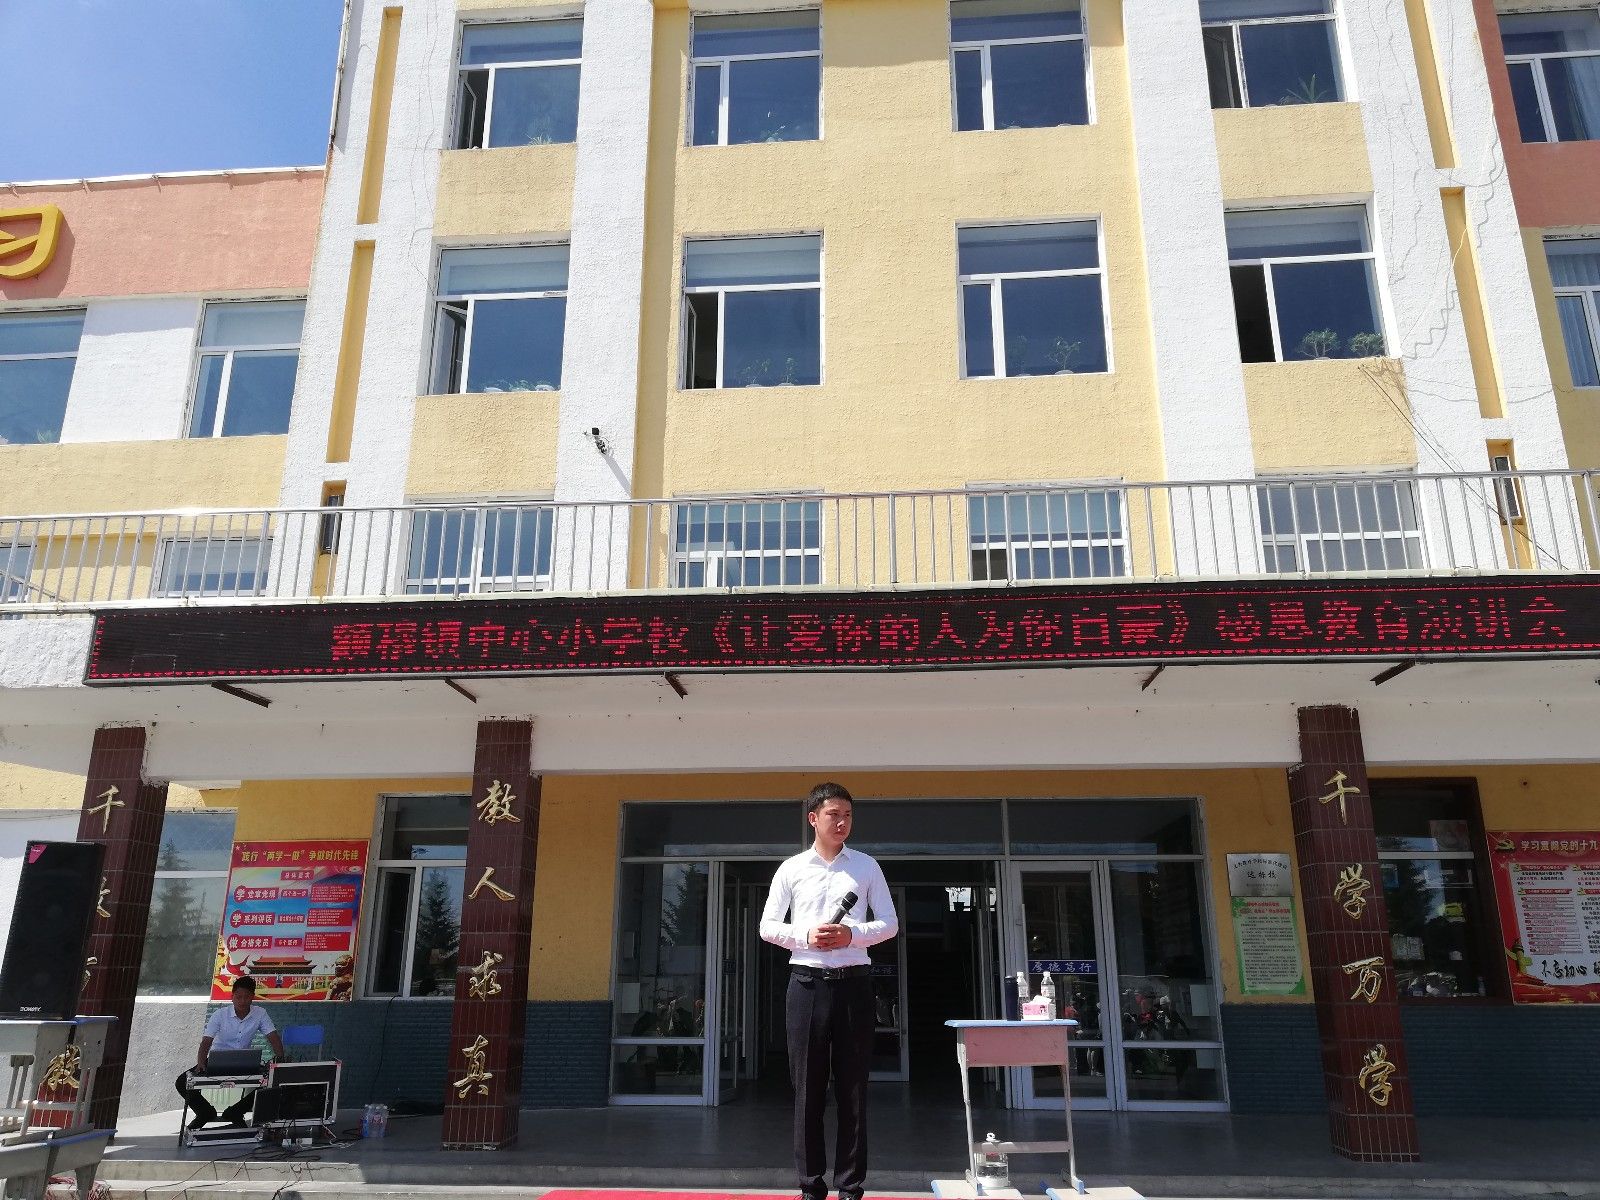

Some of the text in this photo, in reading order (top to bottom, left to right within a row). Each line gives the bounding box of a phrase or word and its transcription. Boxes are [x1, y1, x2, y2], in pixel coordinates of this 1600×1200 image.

[453, 780, 521, 1098] 教人求真
[1318, 770, 1397, 1106] 千学万学
